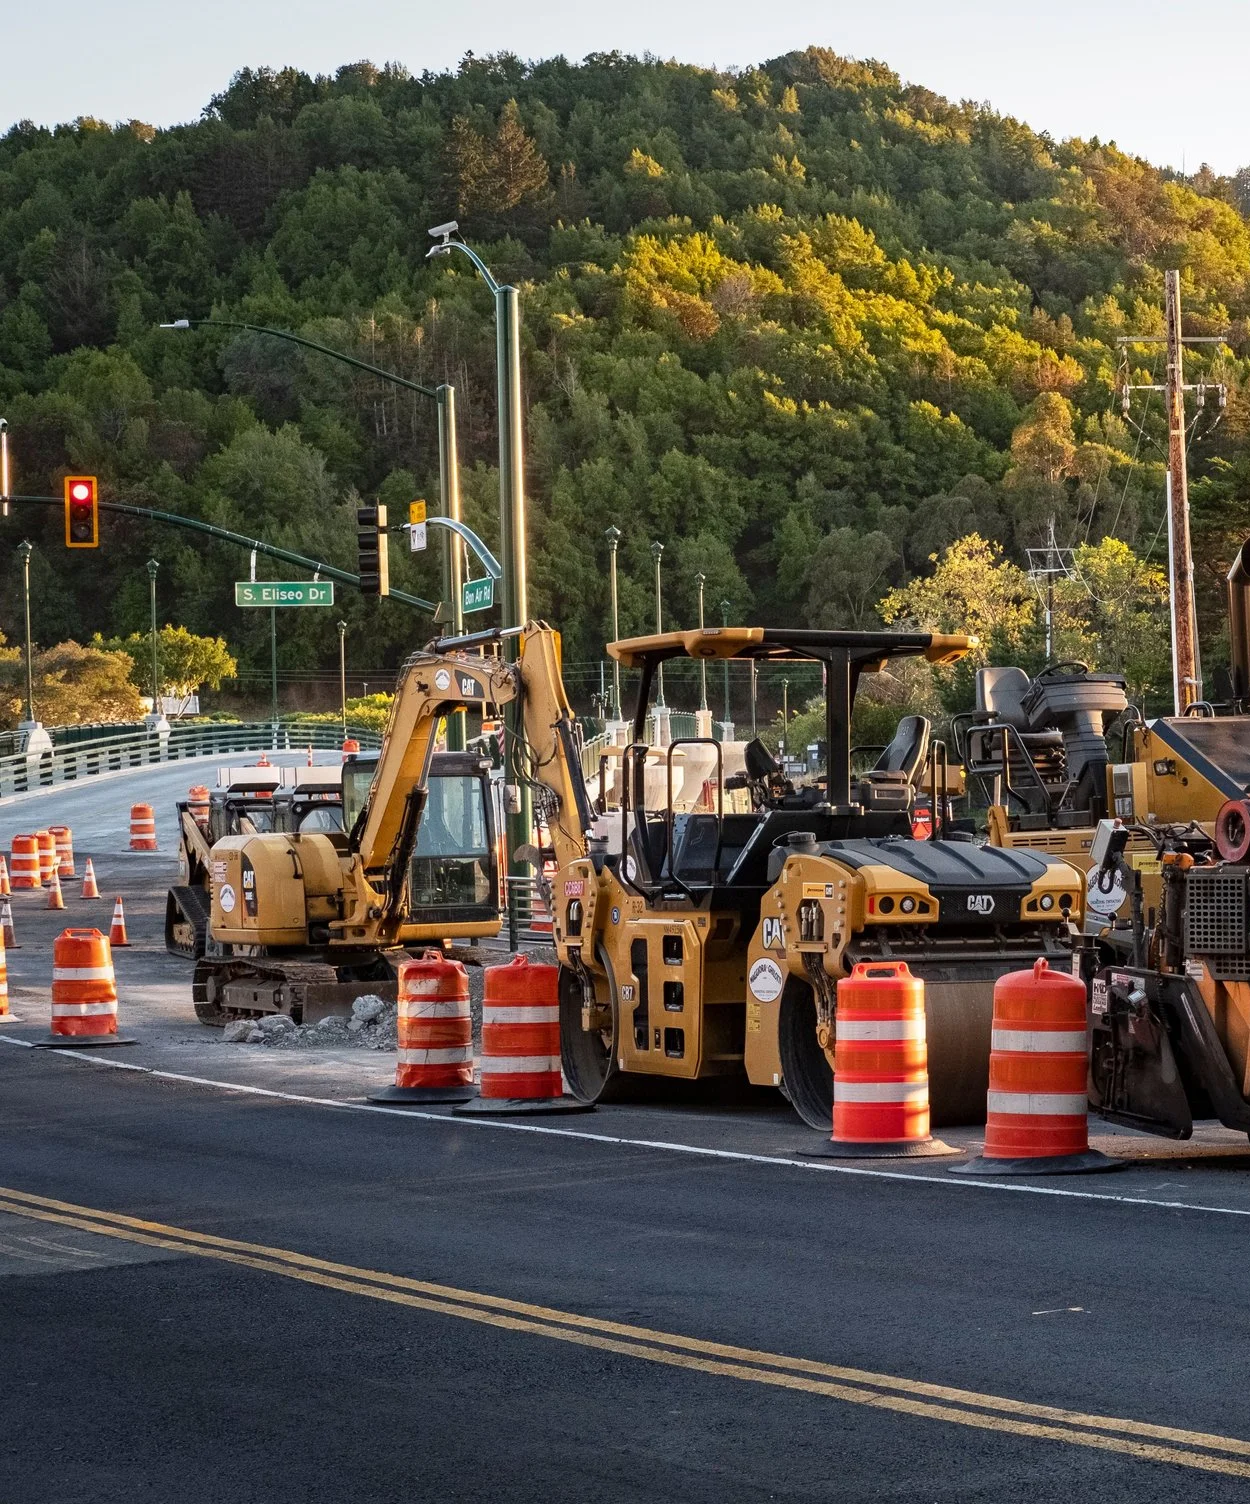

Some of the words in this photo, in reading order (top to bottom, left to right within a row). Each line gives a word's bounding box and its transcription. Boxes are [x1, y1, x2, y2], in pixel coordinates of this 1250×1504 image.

[243, 588, 257, 601] S.
[262, 588, 304, 601] Eliseo
[309, 588, 326, 600] Dr
[475, 587, 483, 603] Air
[484, 585, 490, 600] Rd
[461, 678, 475, 696] CAT
[243, 870, 255, 889] CAT
[967, 894, 992, 911] CAT
[622, 985, 633, 1000] CB7
